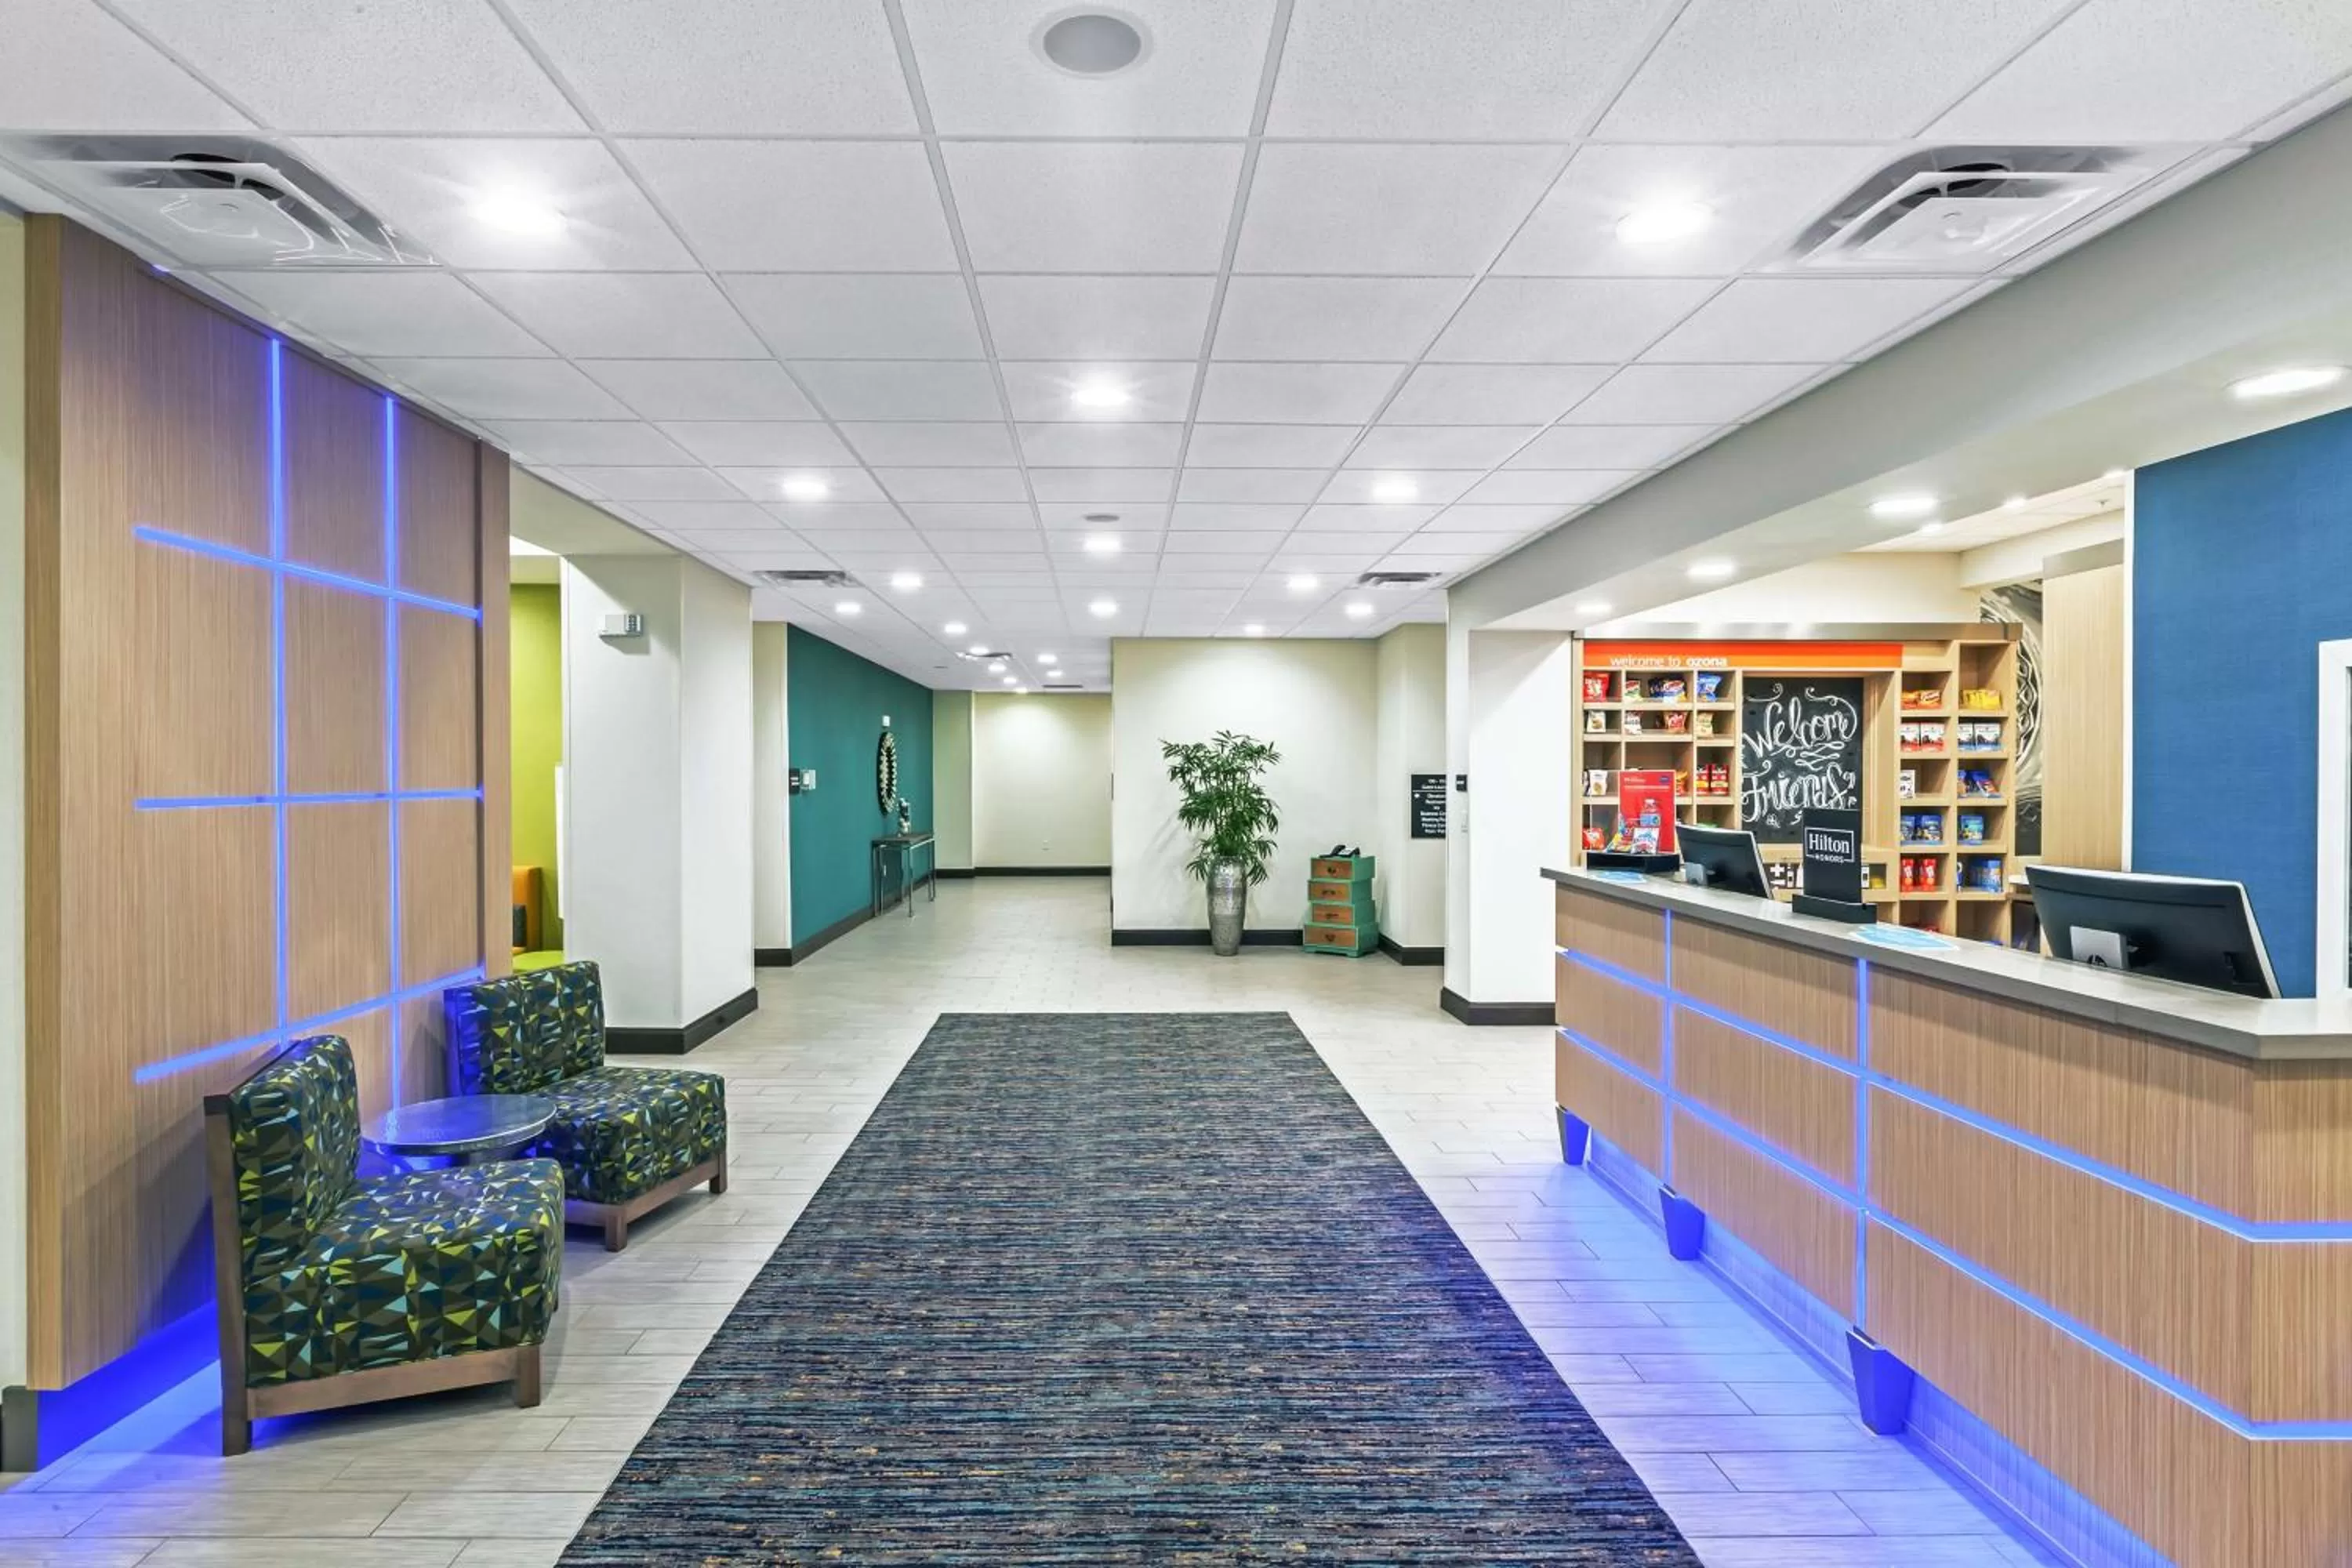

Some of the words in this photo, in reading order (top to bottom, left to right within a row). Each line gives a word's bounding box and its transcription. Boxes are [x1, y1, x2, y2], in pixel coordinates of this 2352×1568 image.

[1610, 655, 1664, 666] welcome
[1668, 655, 1682, 666] to
[1809, 833, 1850, 854] Hilton
